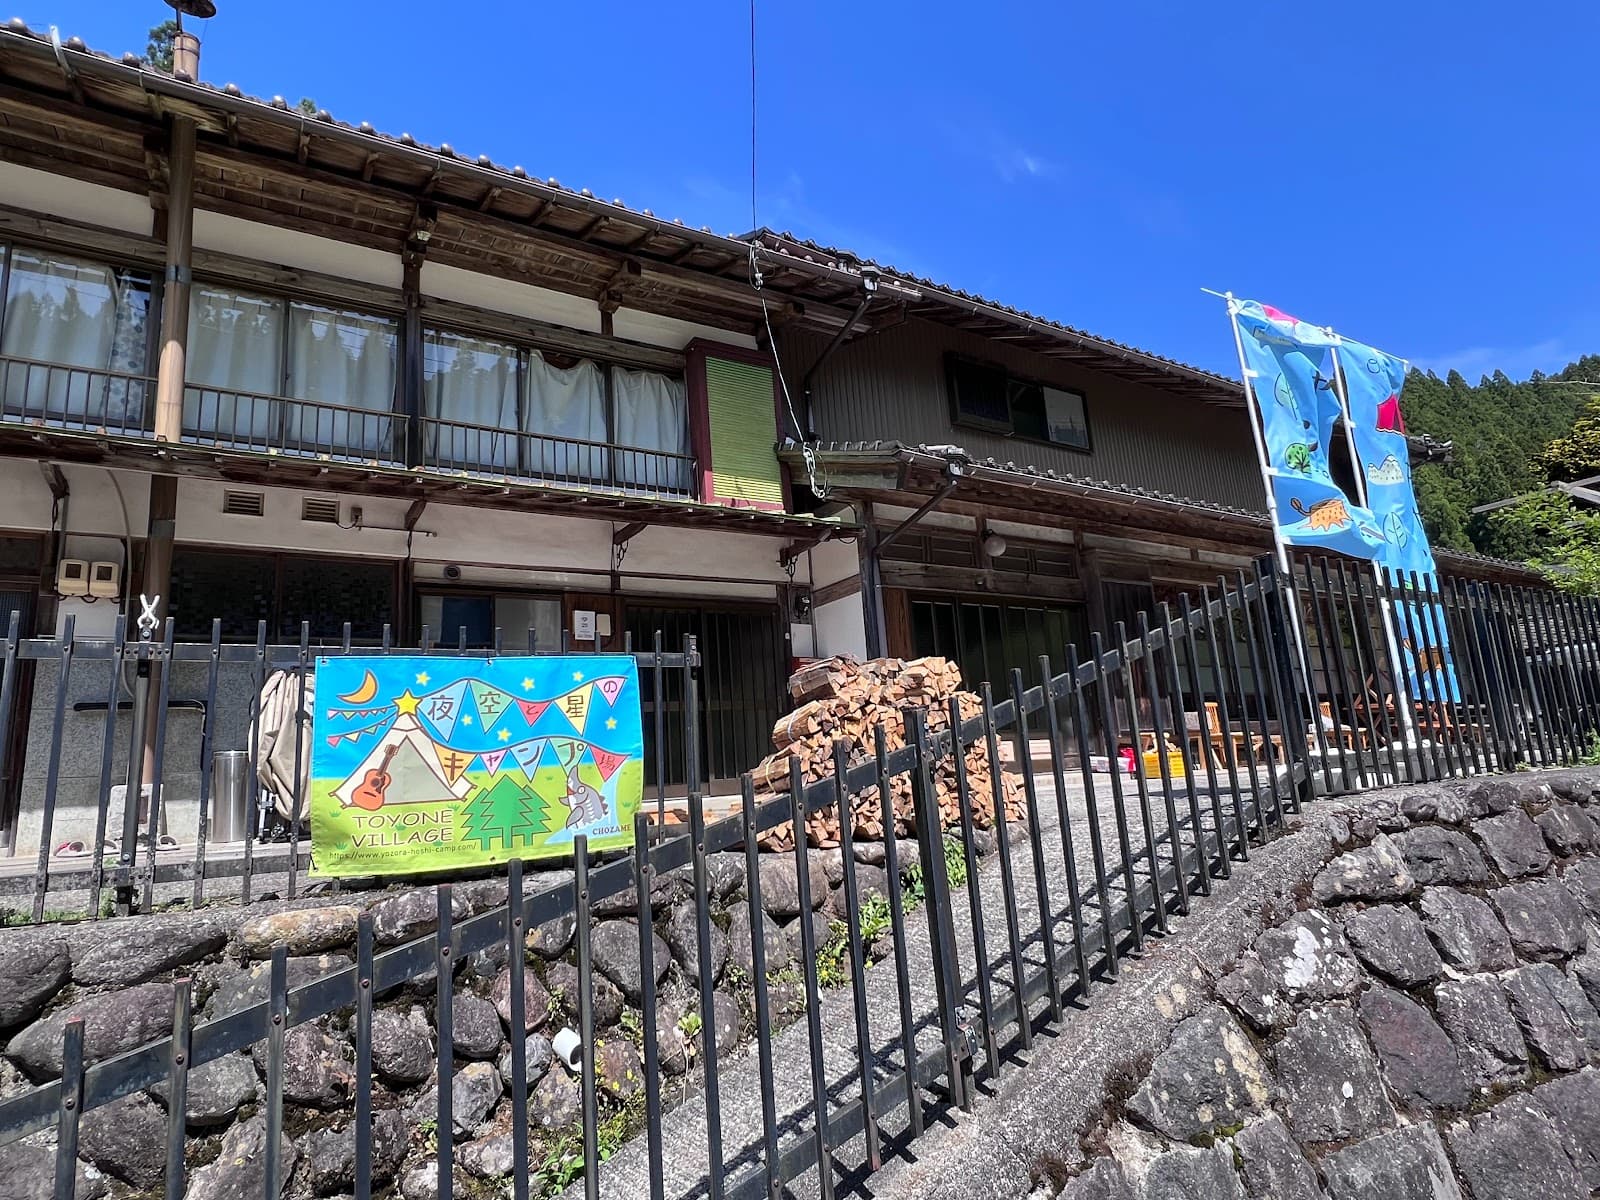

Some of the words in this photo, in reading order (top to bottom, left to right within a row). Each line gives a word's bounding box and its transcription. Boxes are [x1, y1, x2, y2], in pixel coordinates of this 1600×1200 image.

[427, 681, 618, 722] 夜空と星の
[443, 742, 616, 781] キャンプ場
[352, 809, 453, 829] TOYONE
[592, 823, 632, 835] CHOZAME
[352, 828, 453, 848] VILLAGE
